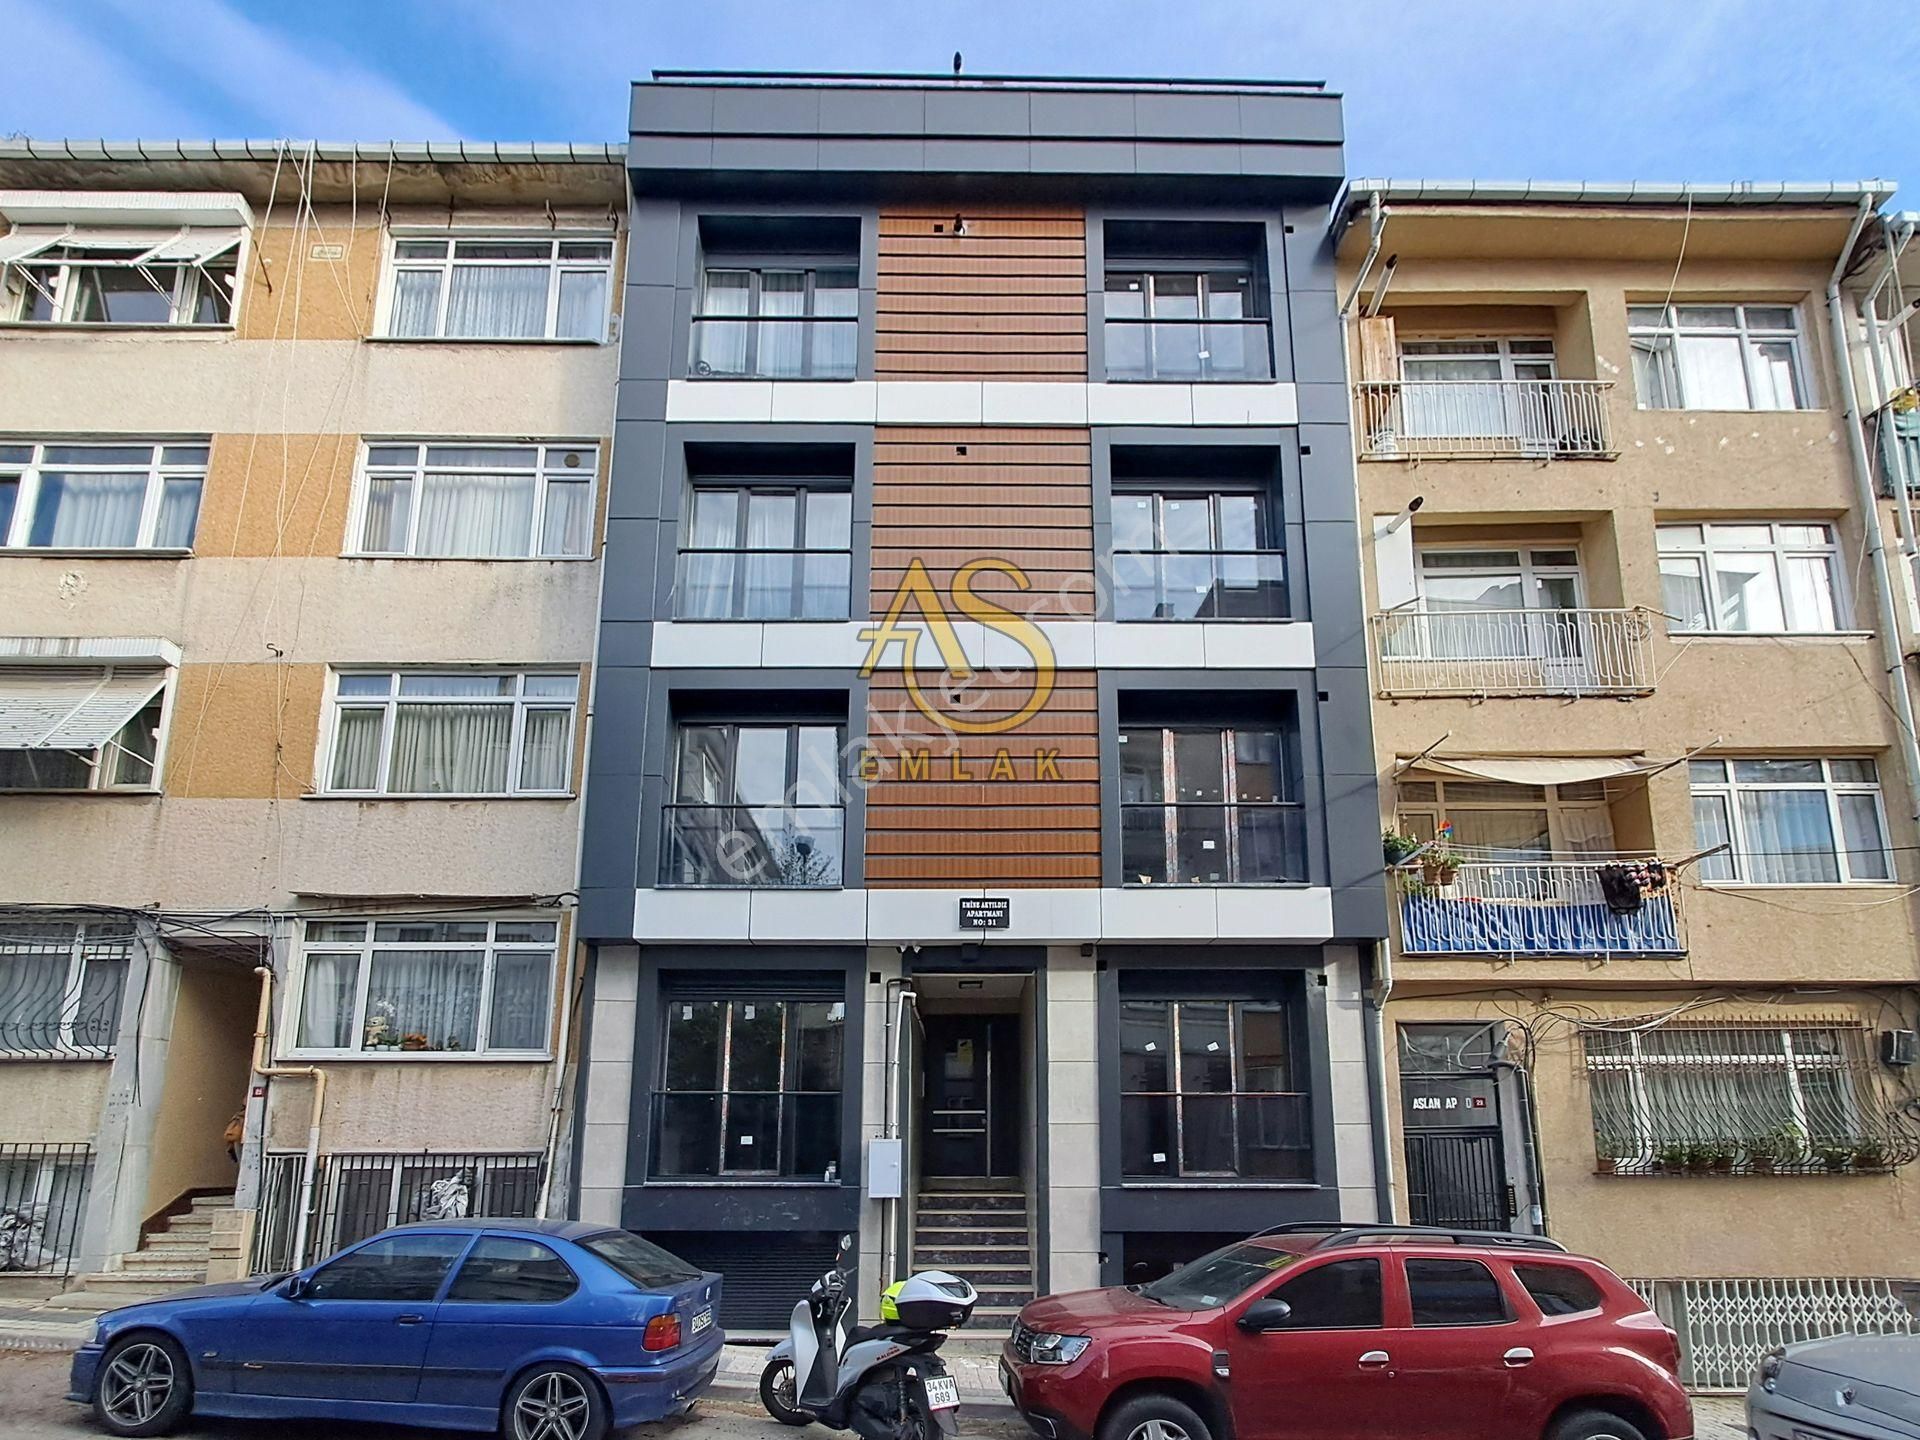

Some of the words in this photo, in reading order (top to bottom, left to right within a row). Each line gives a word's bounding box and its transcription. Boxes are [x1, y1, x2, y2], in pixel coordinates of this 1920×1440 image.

[966, 910, 1003, 918] APARTMANI
[1413, 1097, 1441, 1110] ASLAN
[1445, 1097, 1458, 1109] AP
[934, 1391, 951, 1403] 689
